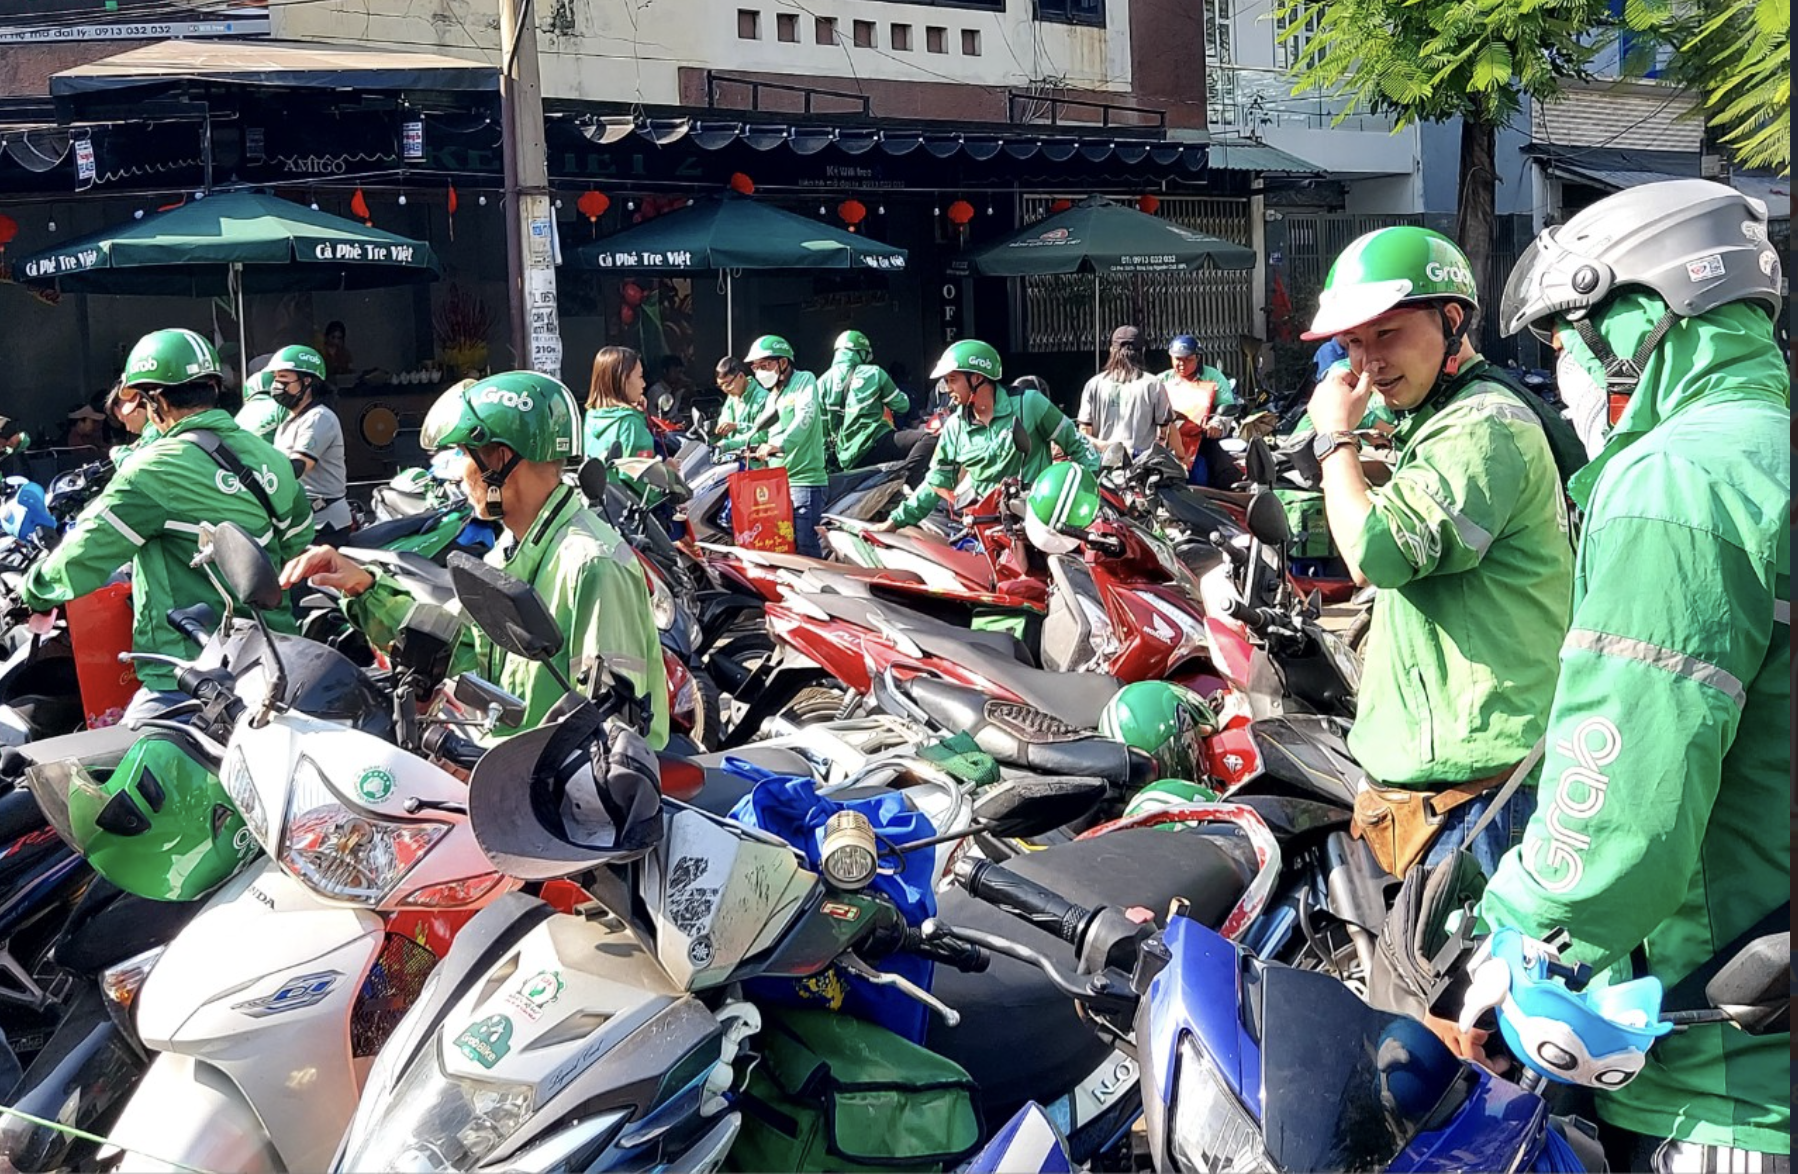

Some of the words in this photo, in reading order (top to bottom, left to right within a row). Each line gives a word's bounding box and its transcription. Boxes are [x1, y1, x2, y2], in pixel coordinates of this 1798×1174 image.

[94, 27, 122, 36] 0913
[125, 26, 147, 35] 032
[151, 25, 172, 34] 032
[284, 160, 346, 173] AMIGO
[58, 255, 78, 271] Tre
[315, 242, 333, 259] Cà
[336, 243, 361, 260] Phê
[364, 244, 387, 260] Tre
[390, 244, 413, 266] Việt
[598, 251, 613, 267] Cà
[615, 250, 638, 267] Phê
[641, 252, 663, 266] Tre
[666, 250, 692, 269] Việt
[1426, 261, 1470, 284] Grab
[298, 352, 321, 364] Grab
[968, 355, 993, 370] Grab
[480, 386, 534, 412] Grab
[215, 464, 279, 494] Gb
[1522, 716, 1622, 893] Grab
[462, 1031, 498, 1062] GrabBike
